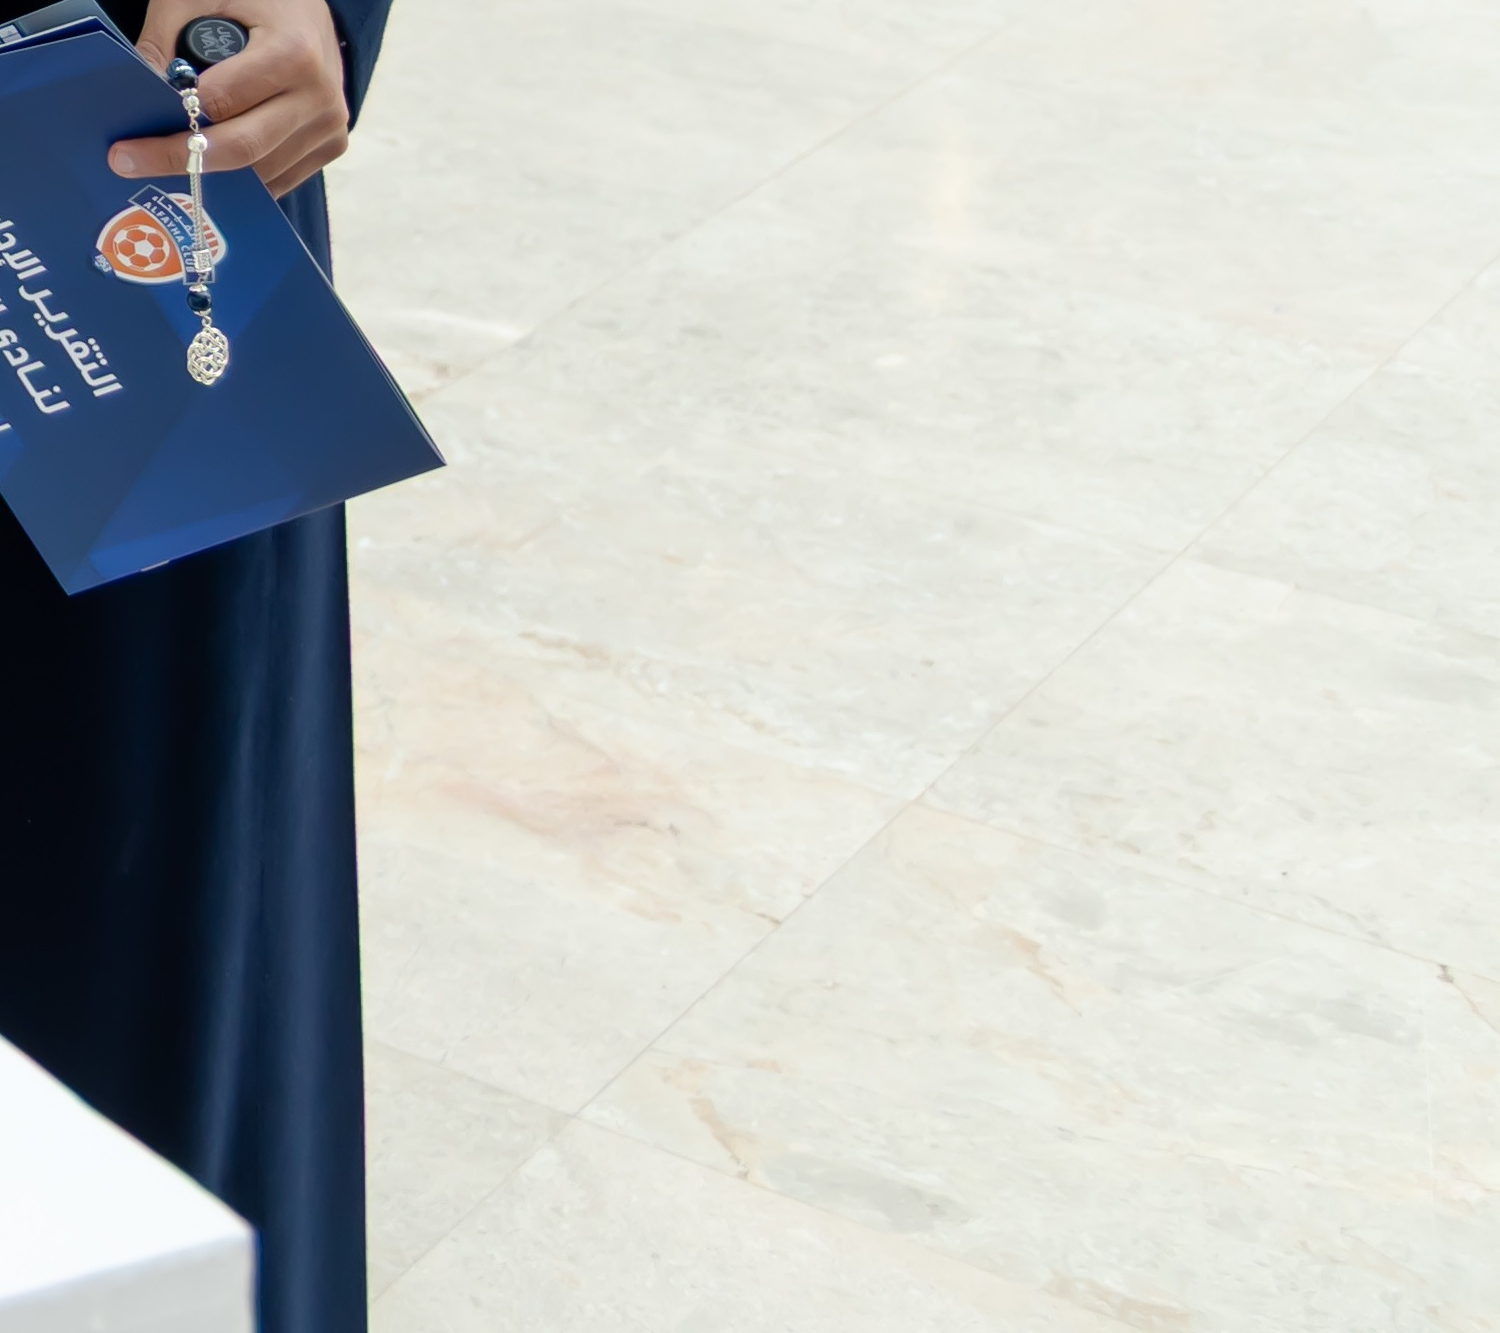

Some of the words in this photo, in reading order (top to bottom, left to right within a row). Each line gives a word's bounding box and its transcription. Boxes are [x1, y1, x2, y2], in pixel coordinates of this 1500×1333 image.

[143, 201, 185, 243] ALFAYHA
[180, 244, 195, 274] CLUB
[18, 285, 123, 397] التقرير
